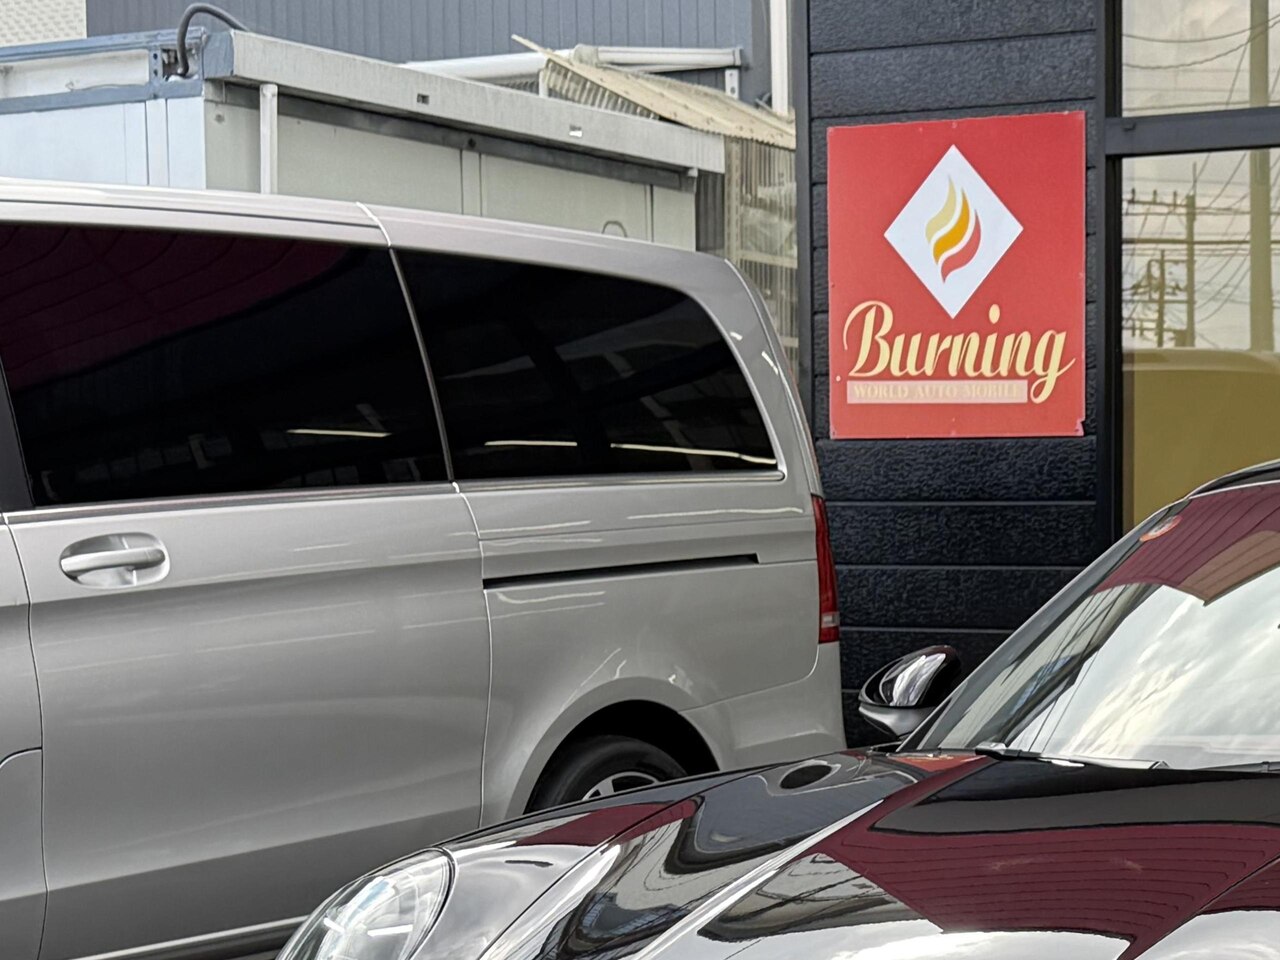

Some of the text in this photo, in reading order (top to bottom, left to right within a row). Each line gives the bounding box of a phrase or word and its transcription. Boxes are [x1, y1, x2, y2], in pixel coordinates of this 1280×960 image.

[843, 301, 1076, 404] Burning
[853, 383, 1020, 399] WORLD AUTO MOBILE
